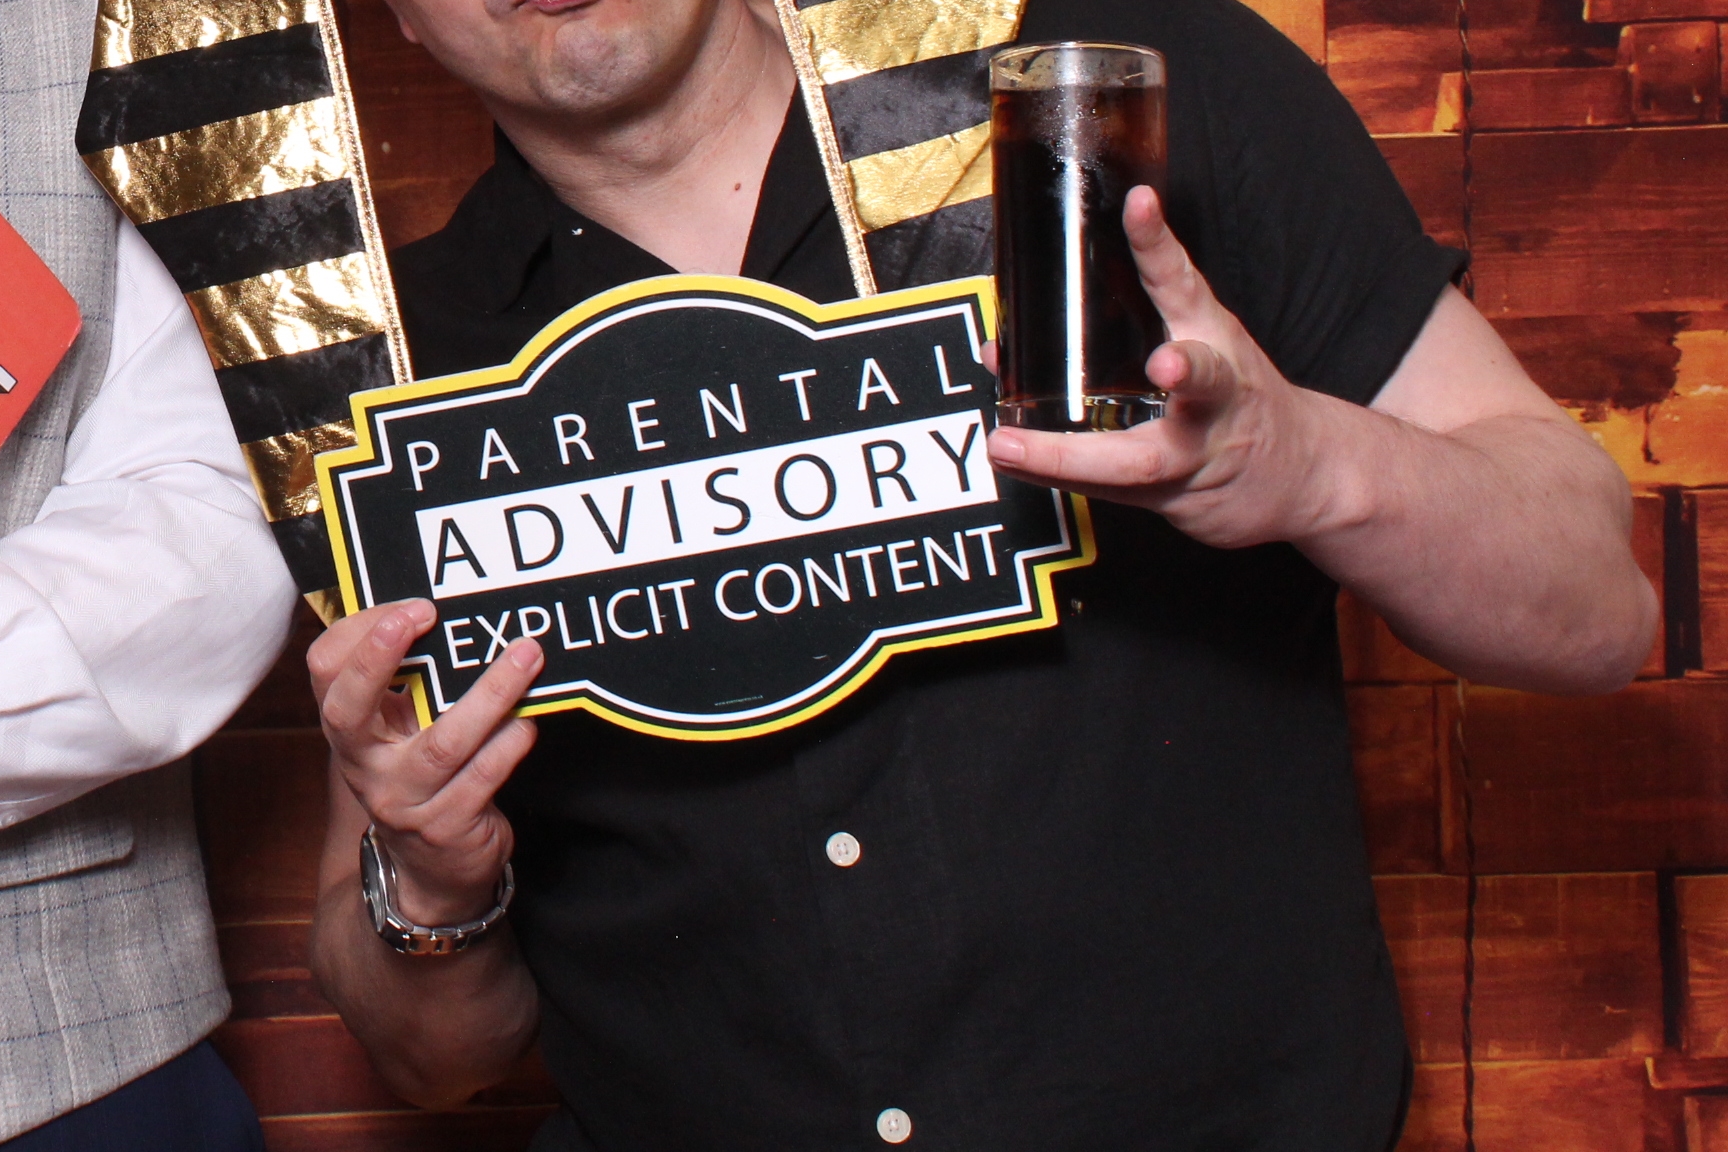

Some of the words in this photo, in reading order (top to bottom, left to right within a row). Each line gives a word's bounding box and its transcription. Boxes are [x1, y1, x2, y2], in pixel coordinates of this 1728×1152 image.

[406, 344, 973, 492] PARENTAL
[433, 421, 985, 586] ADVISORY
[443, 578, 696, 669] EXPLICIT
[715, 523, 1006, 622] CONTENT
